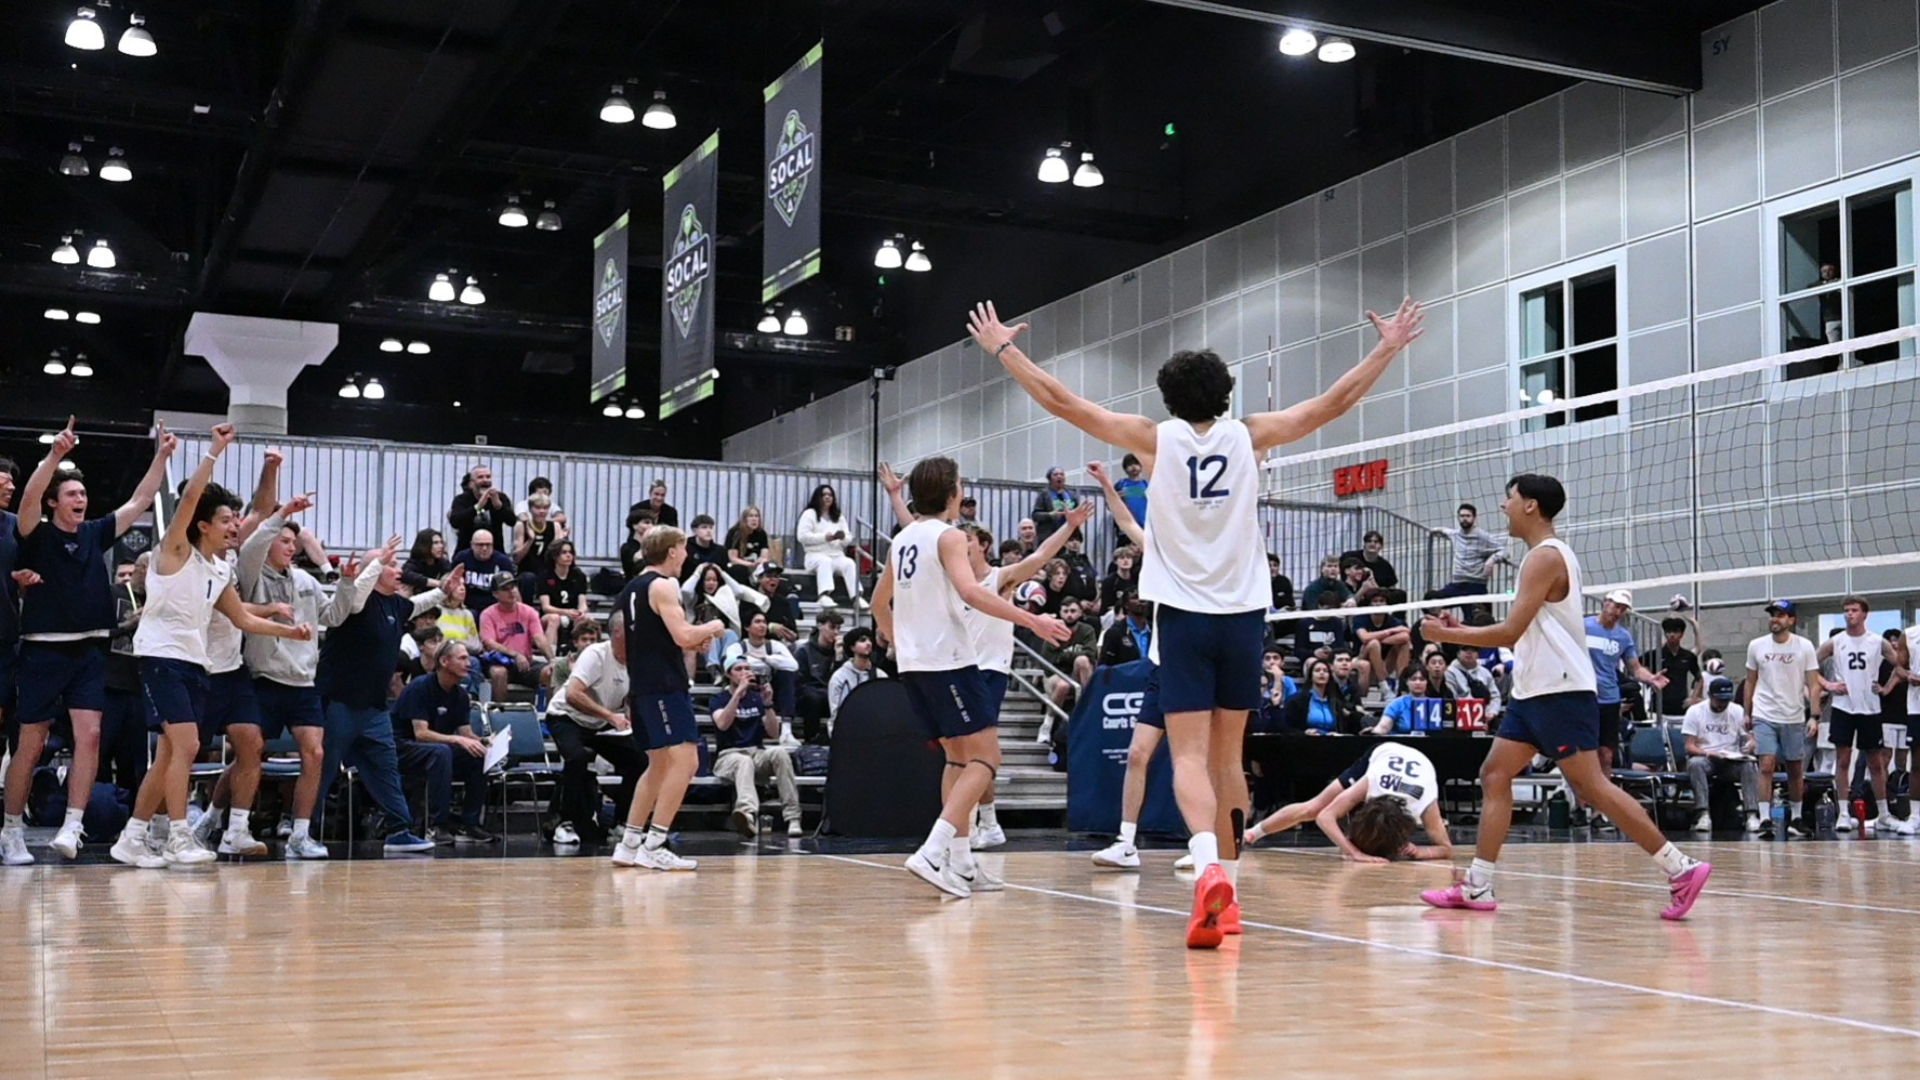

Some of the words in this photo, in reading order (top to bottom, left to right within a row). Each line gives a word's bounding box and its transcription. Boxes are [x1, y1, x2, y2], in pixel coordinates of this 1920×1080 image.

[1713, 36, 1731, 55] SY
[770, 143, 812, 190] SOCAL
[667, 246, 707, 292] SOCAL
[596, 286, 622, 317] SOCAL
[1186, 454, 1230, 499] 12
[1334, 459, 1388, 496] EXIT
[536, 541, 545, 556] 7
[898, 544, 918, 580] 13
[206, 579, 212, 599] 1
[560, 590, 569, 604] 2
[1848, 652, 1867, 670] 25
[1445, 702, 1452, 715] 3
[1462, 702, 1484, 727] 12
[1388, 756, 1421, 778] 32
